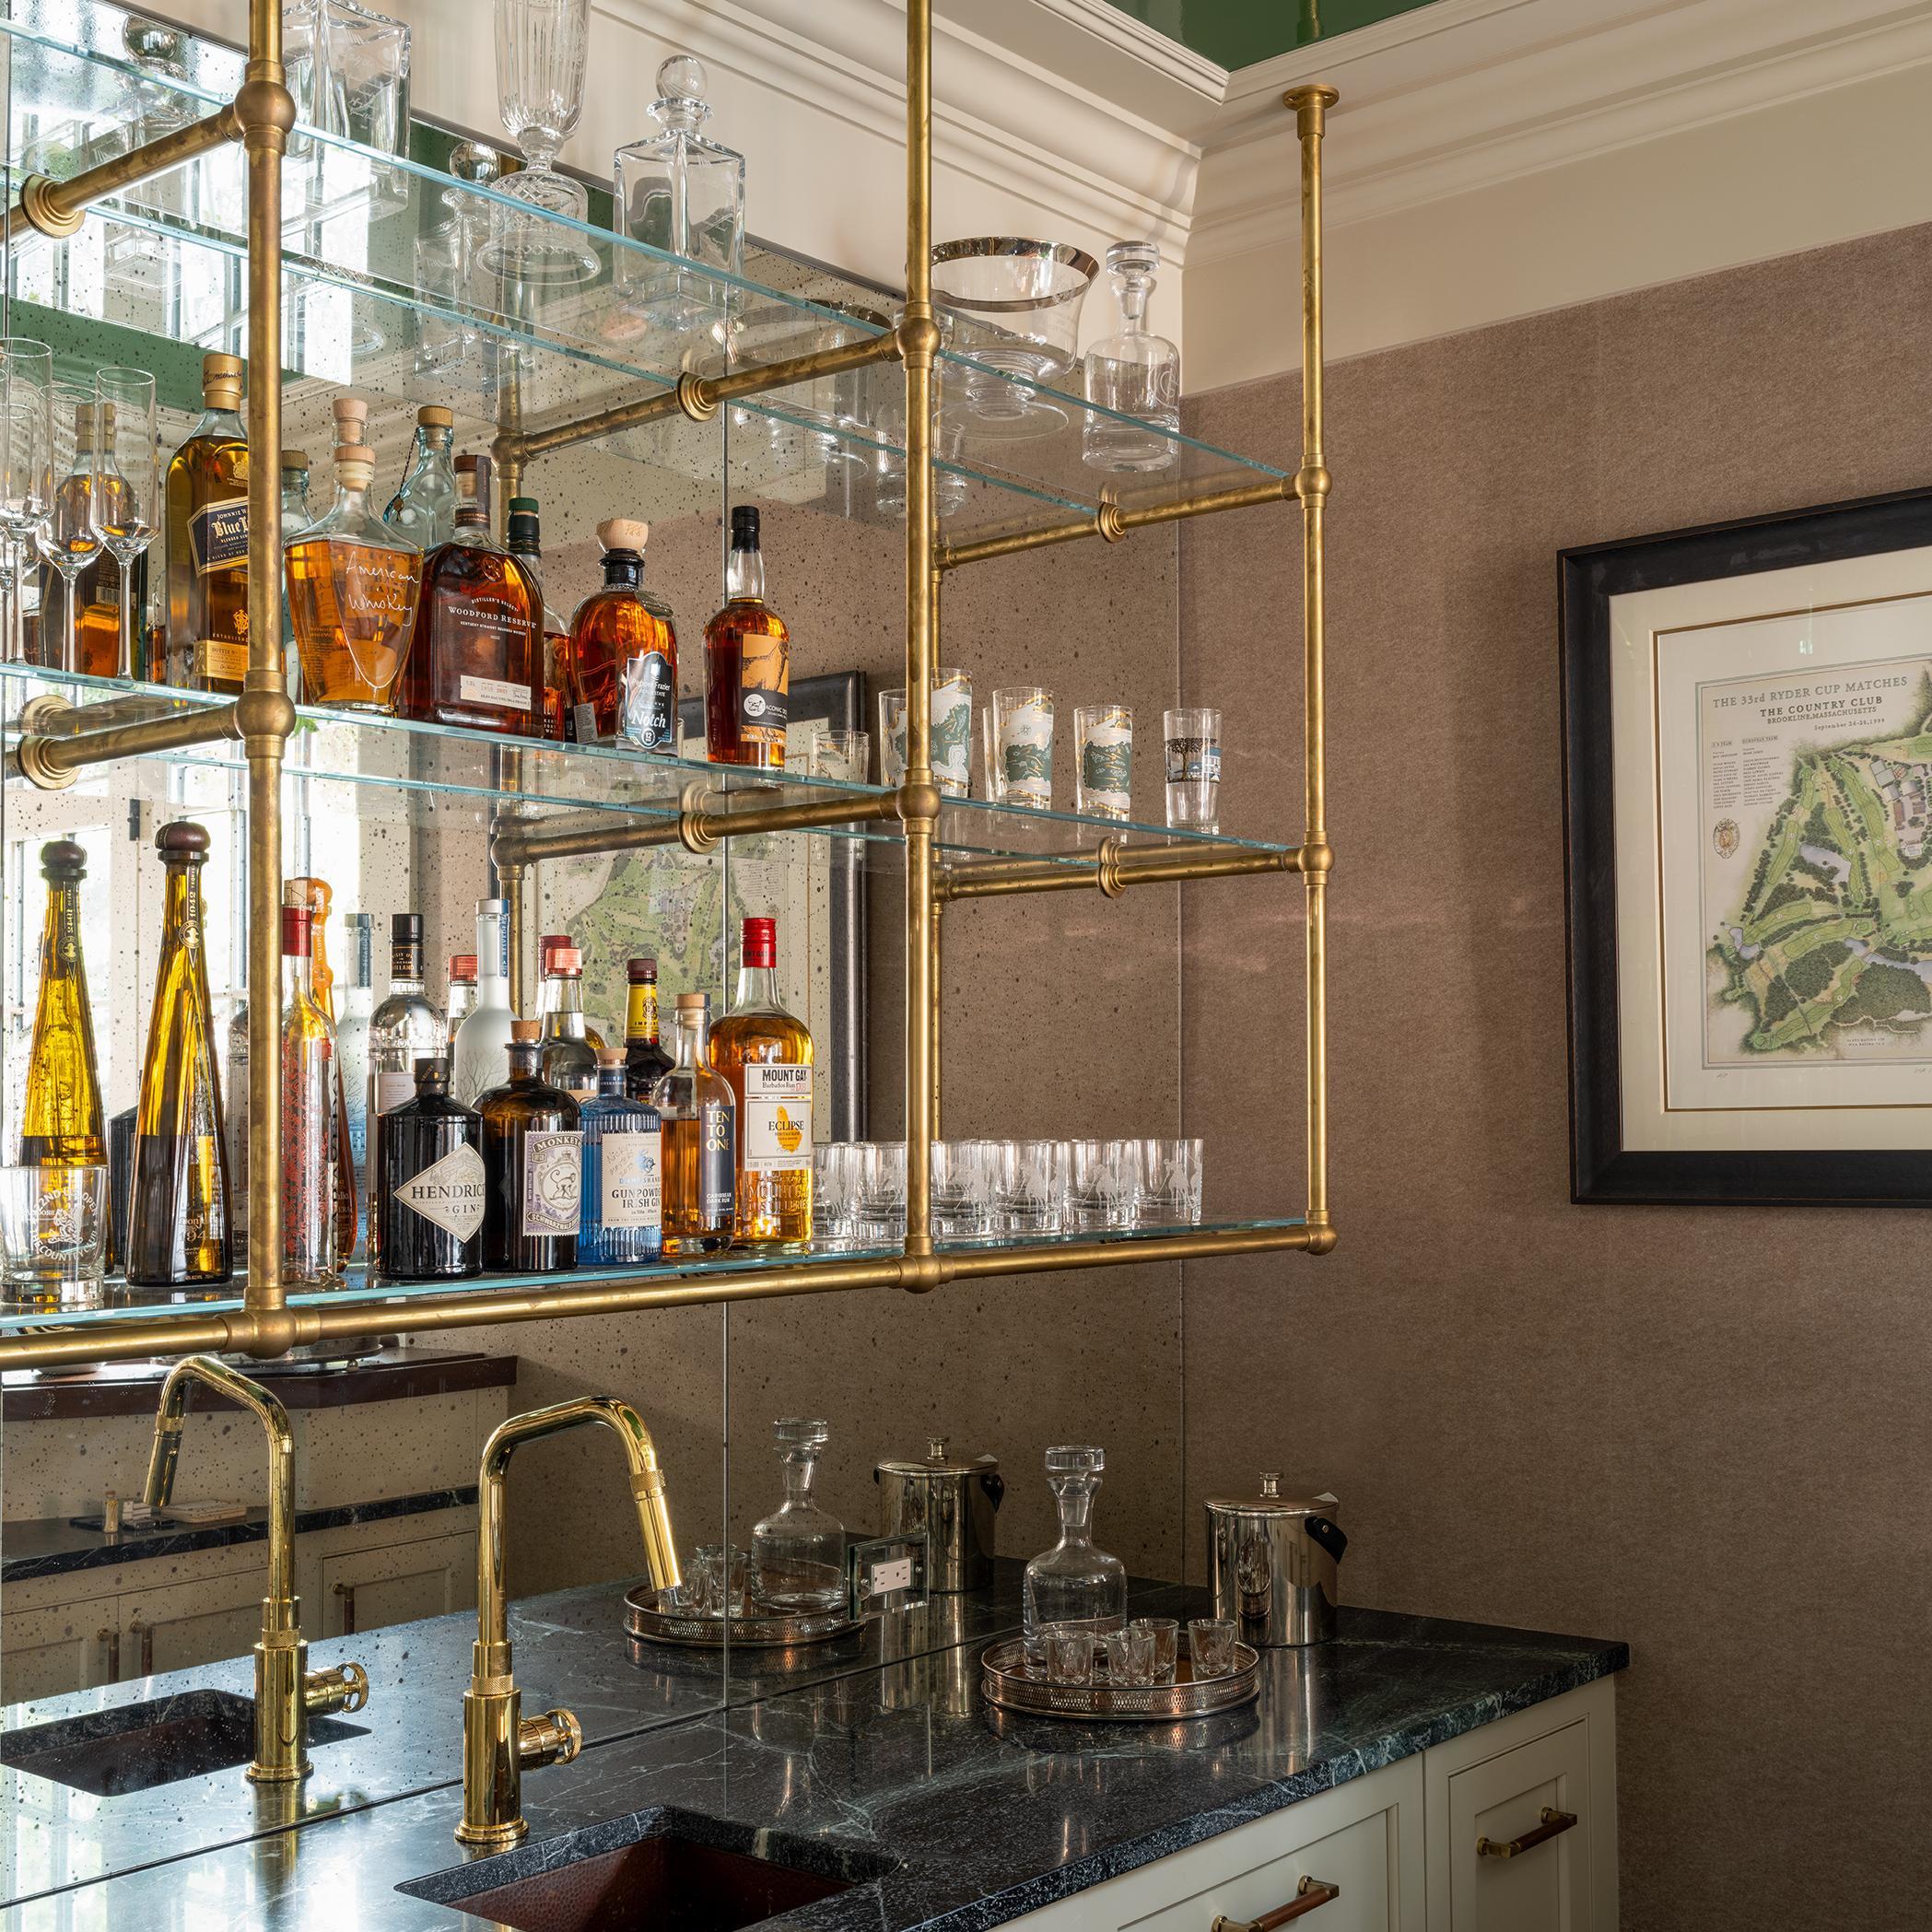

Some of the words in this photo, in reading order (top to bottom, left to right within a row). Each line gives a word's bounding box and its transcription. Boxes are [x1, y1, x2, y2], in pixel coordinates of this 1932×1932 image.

[217, 509, 241, 521] JOHNNIE
[211, 520, 240, 539] Blue
[345, 551, 420, 585] American
[448, 605, 498, 621] WOODFORD
[501, 615, 535, 629] RESERVE
[654, 681, 671, 691] Frazier
[1713, 697, 1737, 708] THE
[1741, 693, 1765, 706] 33rd
[1770, 686, 1811, 701] RYDER
[1814, 683, 1841, 696] CUP
[1844, 675, 1908, 693] MATCHES
[1760, 708, 1784, 718] THE
[1787, 700, 1846, 715] COUNTRY
[1850, 696, 1883, 707] CLUB
[630, 710, 666, 728] Notch
[188, 891, 196, 919] 1942
[762, 1069, 794, 1082] MOUNT
[795, 1069, 807, 1082] GAY
[706, 1110, 730, 1123] TEN
[706, 1124, 725, 1137] TO
[768, 1120, 804, 1131] ECLIPSE
[537, 1135, 580, 1151] MONKEY
[706, 1138, 730, 1152] ONE
[452, 1203, 477, 1214] GIN
